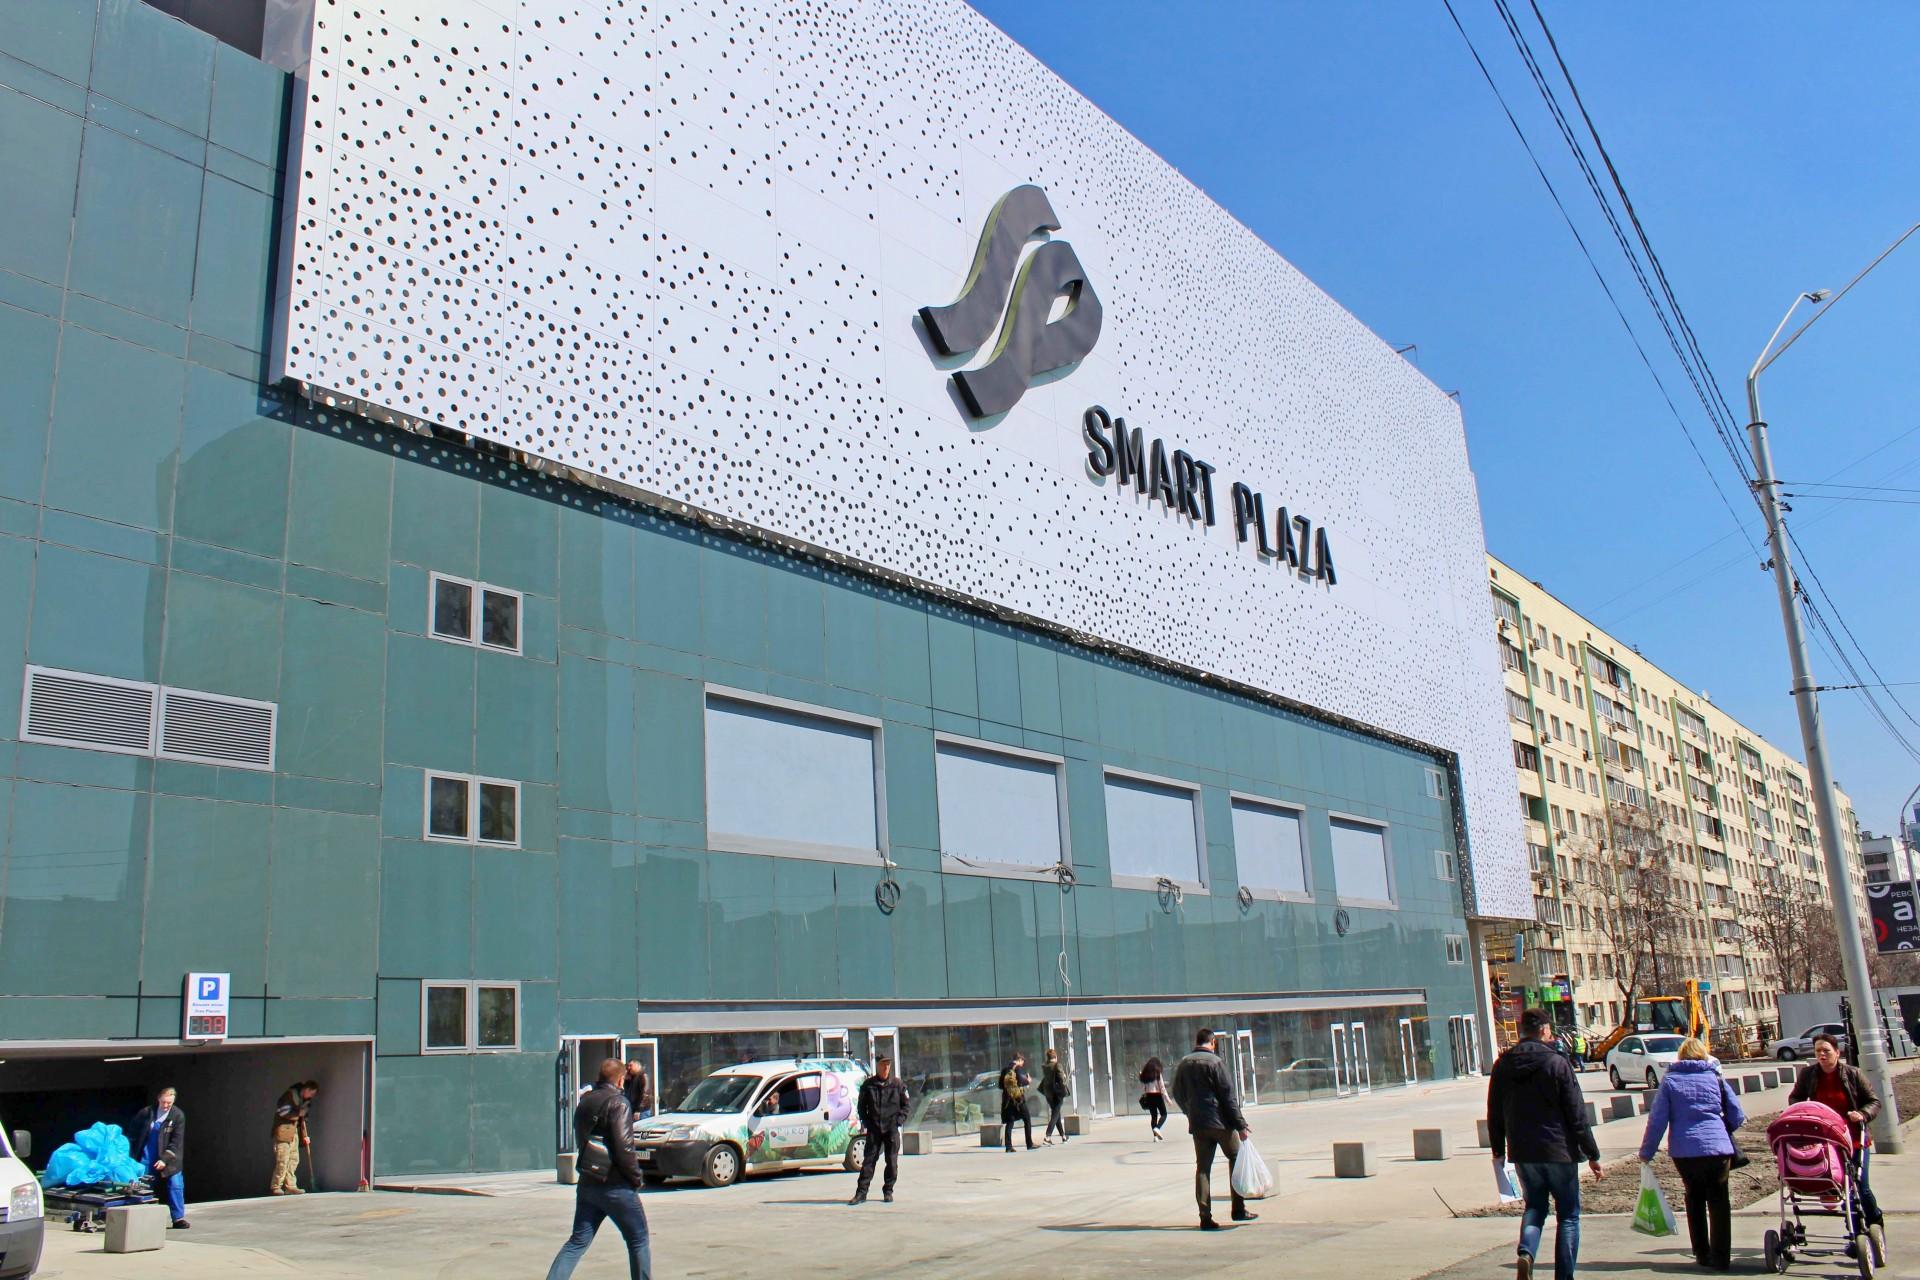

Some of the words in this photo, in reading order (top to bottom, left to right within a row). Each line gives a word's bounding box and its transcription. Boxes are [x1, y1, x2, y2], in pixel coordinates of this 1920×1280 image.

[1083, 405, 1216, 527] SMART
[1232, 481, 1337, 586] PLAZA
[202, 980, 216, 997] P
